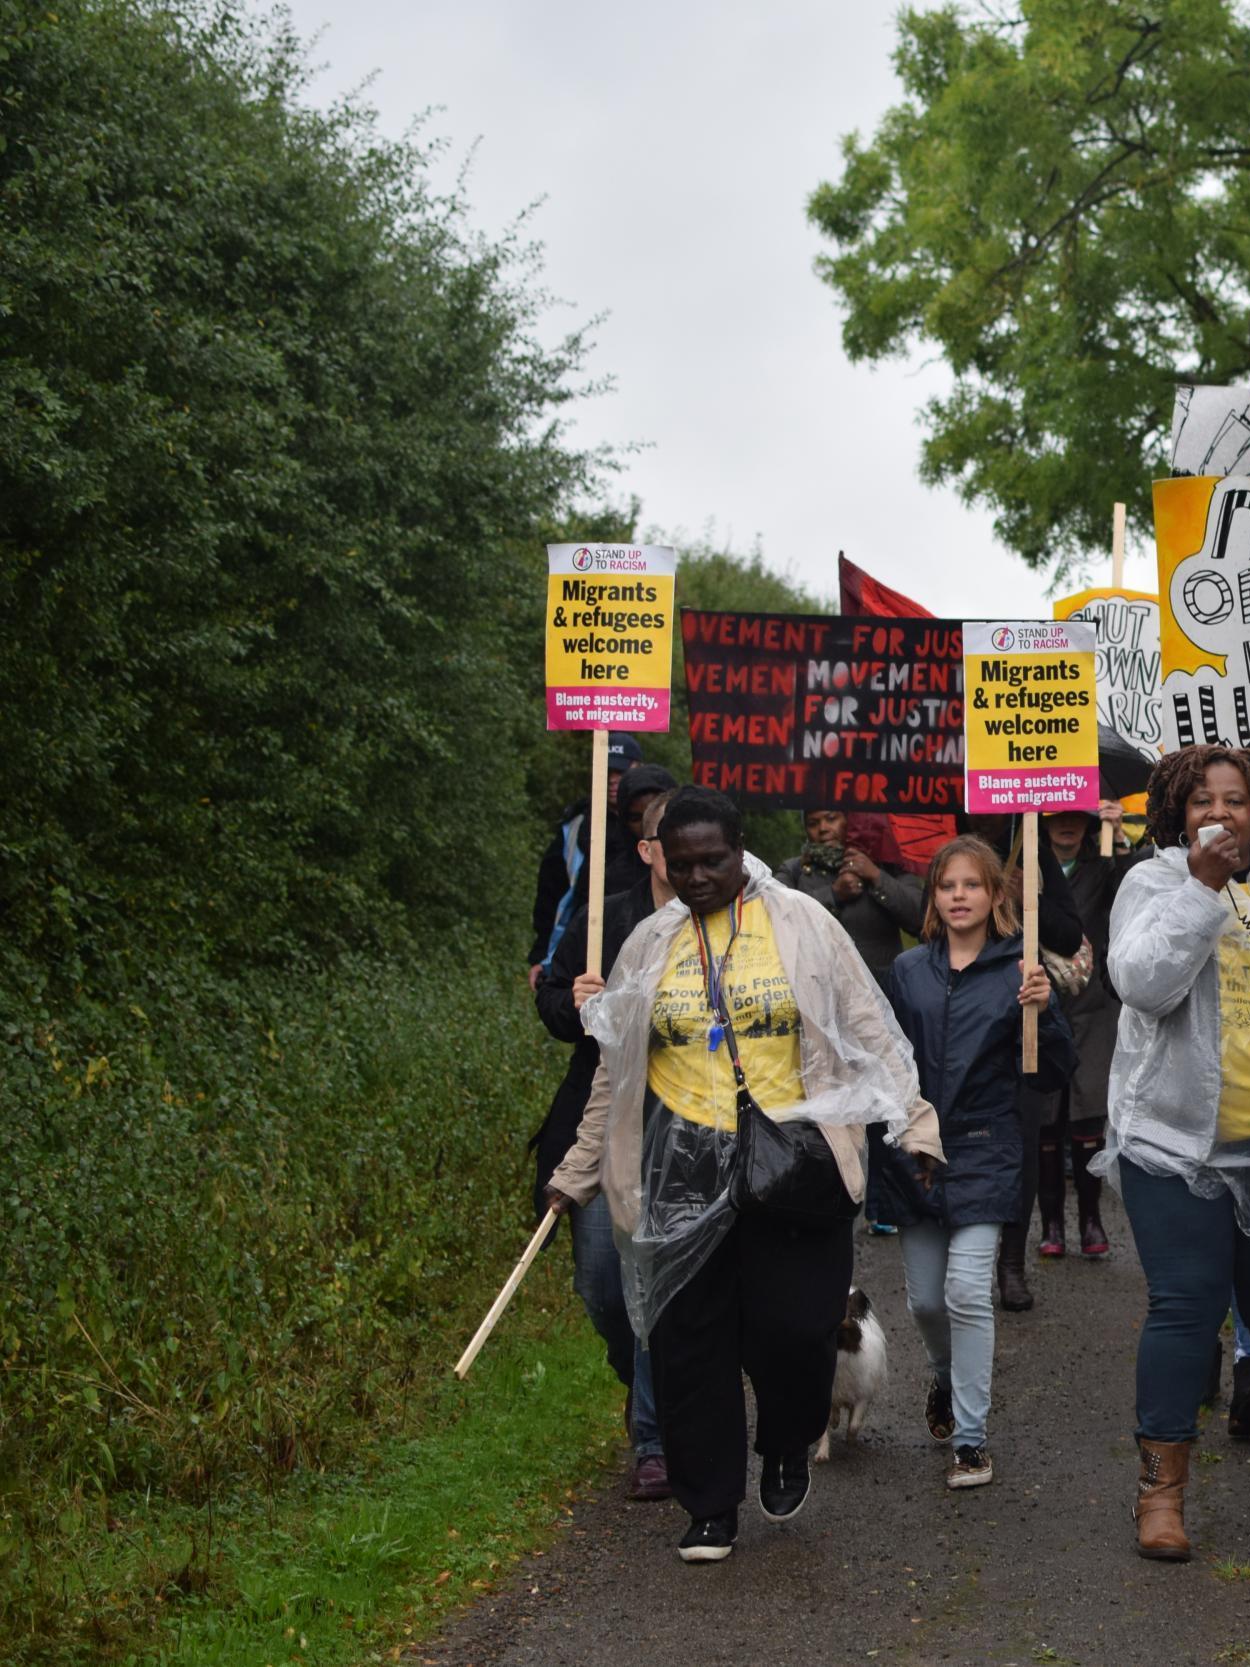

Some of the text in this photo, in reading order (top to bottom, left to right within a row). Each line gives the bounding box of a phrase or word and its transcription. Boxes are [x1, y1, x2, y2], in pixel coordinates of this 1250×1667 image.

[595, 550, 642, 560] STAND UP
[595, 560, 646, 571] TO RACISM
[563, 580, 657, 606] Migrants
[553, 606, 665, 633] & refugees
[1070, 603, 1150, 650] HUT
[563, 633, 653, 655] welcome
[852, 625, 905, 657] FOR
[914, 630, 963, 659] JUS
[1018, 627, 1064, 639] STAND UP
[1018, 638, 1069, 650] TO RACISM
[581, 659, 629, 680] here
[807, 659, 964, 693] MOVEMENT
[981, 660, 1080, 687] Migrants
[555, 692, 659, 710] Blame austerity,
[804, 695, 859, 726] FOR
[973, 687, 1090, 713] & refugees
[566, 708, 646, 723] not migrants
[985, 714, 1080, 736] welcome
[1008, 741, 1058, 762] here
[834, 771, 888, 804] FOR
[979, 773, 1088, 789] Blame austerity,
[991, 789, 1076, 807] not migrants
